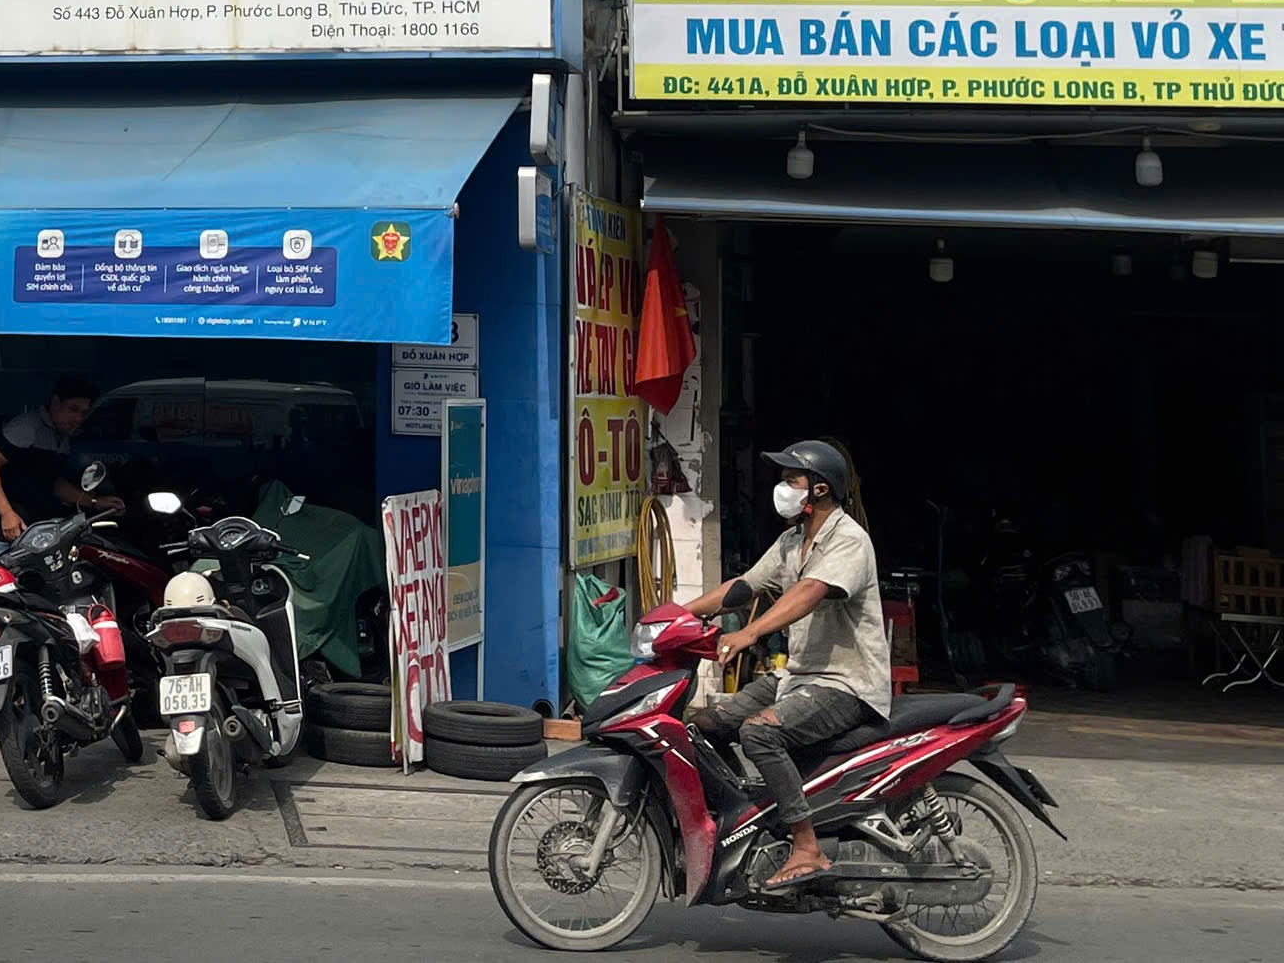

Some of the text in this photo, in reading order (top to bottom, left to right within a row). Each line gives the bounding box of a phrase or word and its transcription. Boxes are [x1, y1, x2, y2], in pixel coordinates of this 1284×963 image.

[53, 0, 480, 21] Số 443 Đỗ Xuân Hợp, P. Phước Long B, Thủ Đức, TP. HCM
[311, 22, 480, 38] Điện Thoại: 1800 1166
[686, 8, 1266, 67] MUA BÁN CÁC LOẠI VỎ XE
[663, 76, 700, 95] ĐC:
[707, 77, 770, 98] 441A,
[777, 71, 807, 95] ĐỖ
[816, 74, 877, 97] XUÂN
[886, 77, 933, 100] HỢP,
[942, 79, 960, 97] P.
[968, 76, 1045, 98] PHƯỚC
[1053, 81, 1114, 100] LONG
[1123, 82, 1145, 102] B,
[1153, 82, 1181, 100] TP
[1189, 76, 1234, 101] THỦ
[295, 265, 309, 273] SIM
[419, 350, 445, 361] XUÂN
[449, 353, 469, 362] HỢP
[423, 381, 442, 391] LÀM
[398, 405, 429, 416] 07:30
[578, 494, 597, 533] SẠC
[169, 677, 203, 694] 76-AH
[165, 693, 206, 711] 058.35
[721, 824, 758, 847] HONDA
